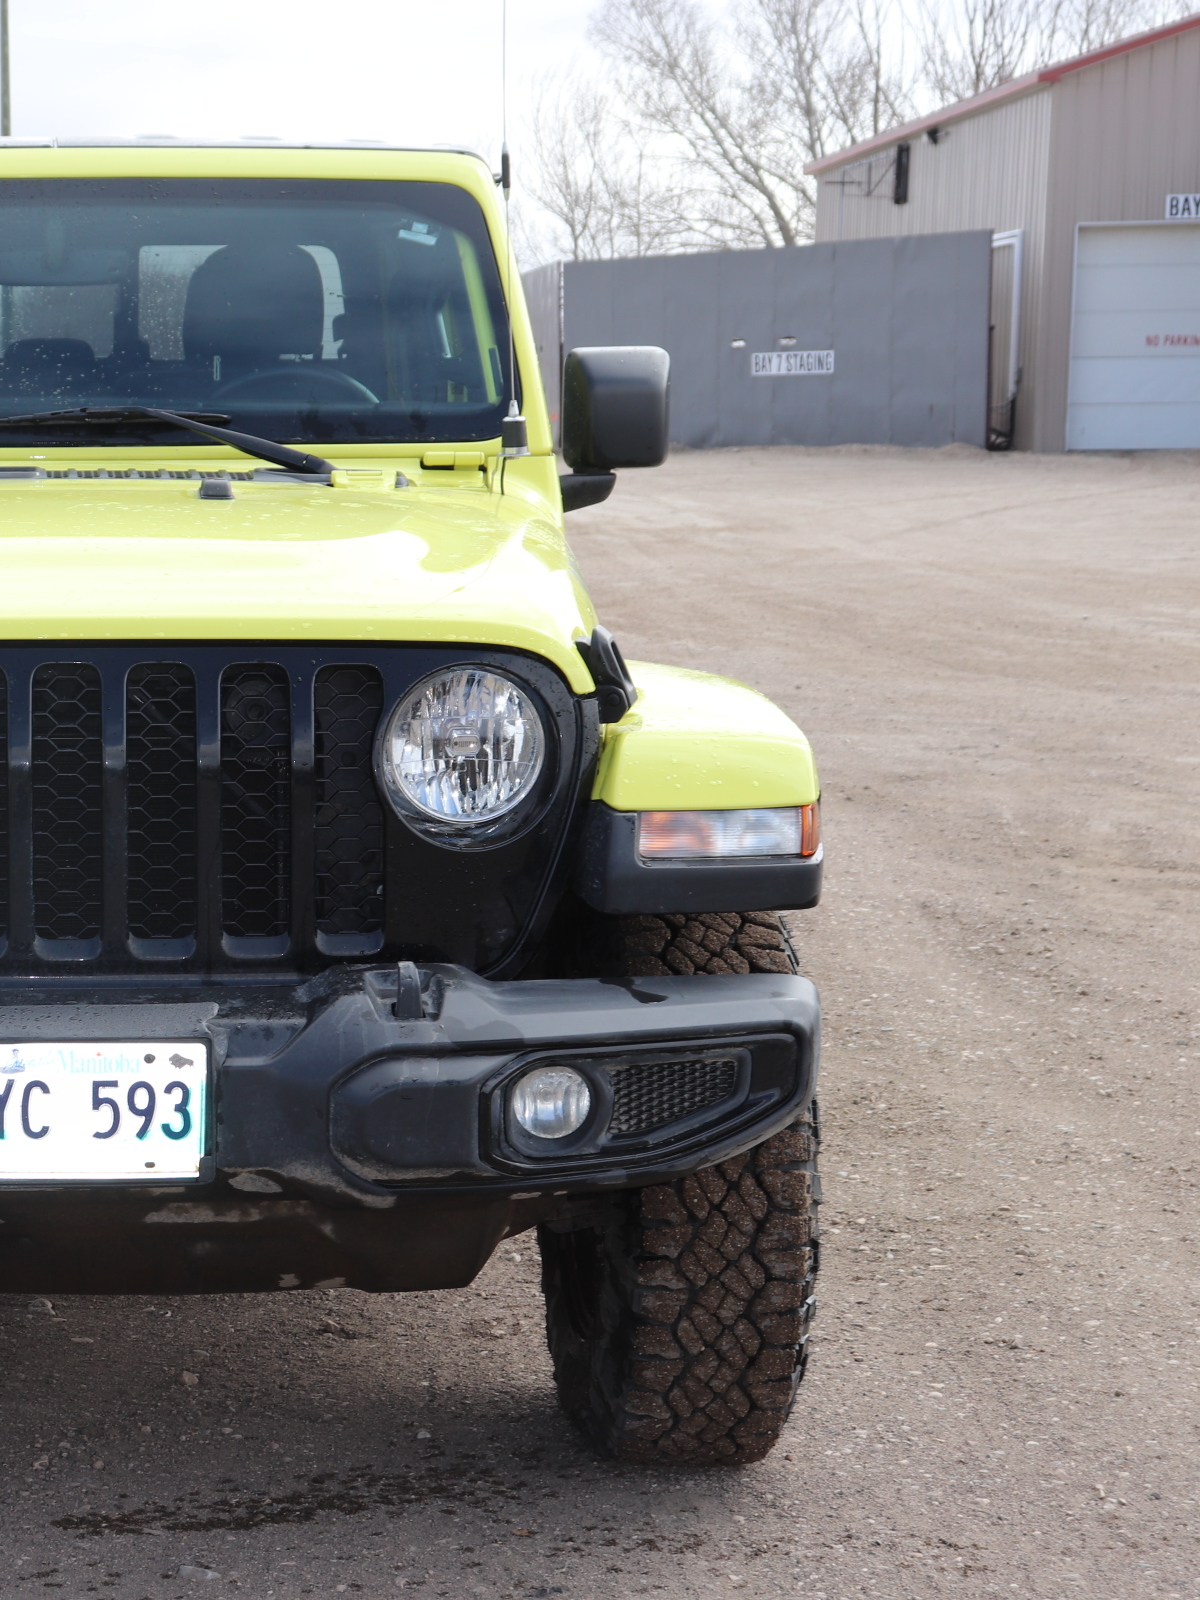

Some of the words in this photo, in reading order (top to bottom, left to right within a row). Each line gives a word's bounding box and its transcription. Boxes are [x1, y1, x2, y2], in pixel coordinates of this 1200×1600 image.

[1170, 196, 1200, 216] BAY
[1145, 334, 1160, 346] NO
[754, 354, 773, 373] BAY
[776, 354, 783, 372] 7
[786, 352, 832, 372] STAGING
[57, 1050, 142, 1074] Manitoba
[92, 1080, 192, 1140] 593
